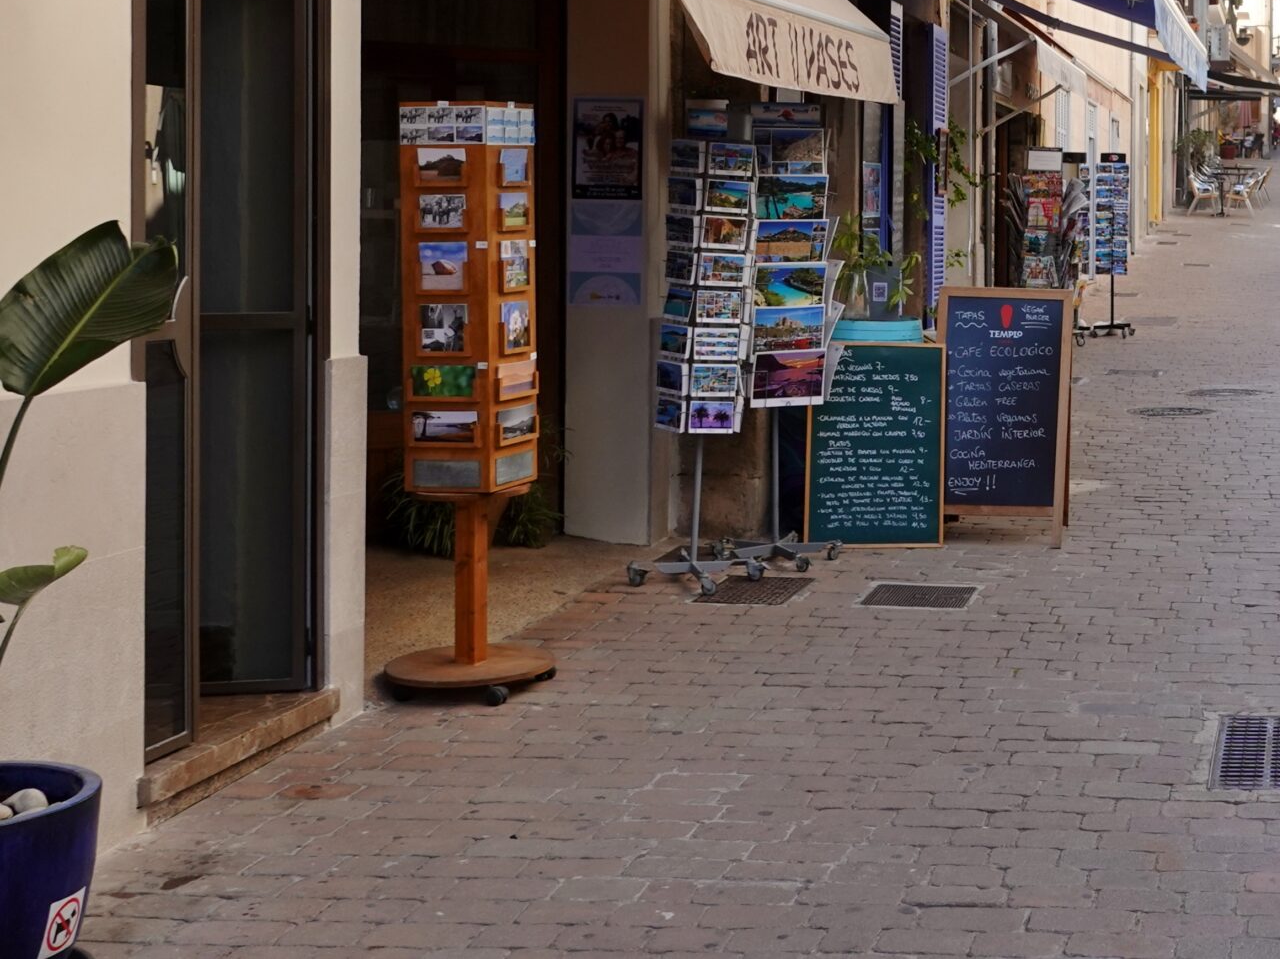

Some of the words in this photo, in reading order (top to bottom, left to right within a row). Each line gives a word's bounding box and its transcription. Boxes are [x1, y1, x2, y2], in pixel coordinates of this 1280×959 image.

[746, 12, 780, 78] ART
[802, 26, 860, 93] VASES
[1021, 304, 1047, 313] VEGAN
[955, 310, 985, 321] TAPAS
[1025, 313, 1050, 322] BURGER
[989, 330, 1023, 339] TEMPLO
[957, 365, 991, 378] Cocina
[956, 381, 991, 392] TARTAS
[998, 381, 1041, 392] CASERAS
[955, 396, 988, 407] Gluten
[995, 396, 1017, 406] FREE
[957, 412, 987, 423] Platos
[954, 425, 993, 441] JARDÍN
[1001, 426, 1046, 441] INTERIOR
[828, 440, 851, 448] PLATOS
[948, 477, 981, 488] ENJOY
